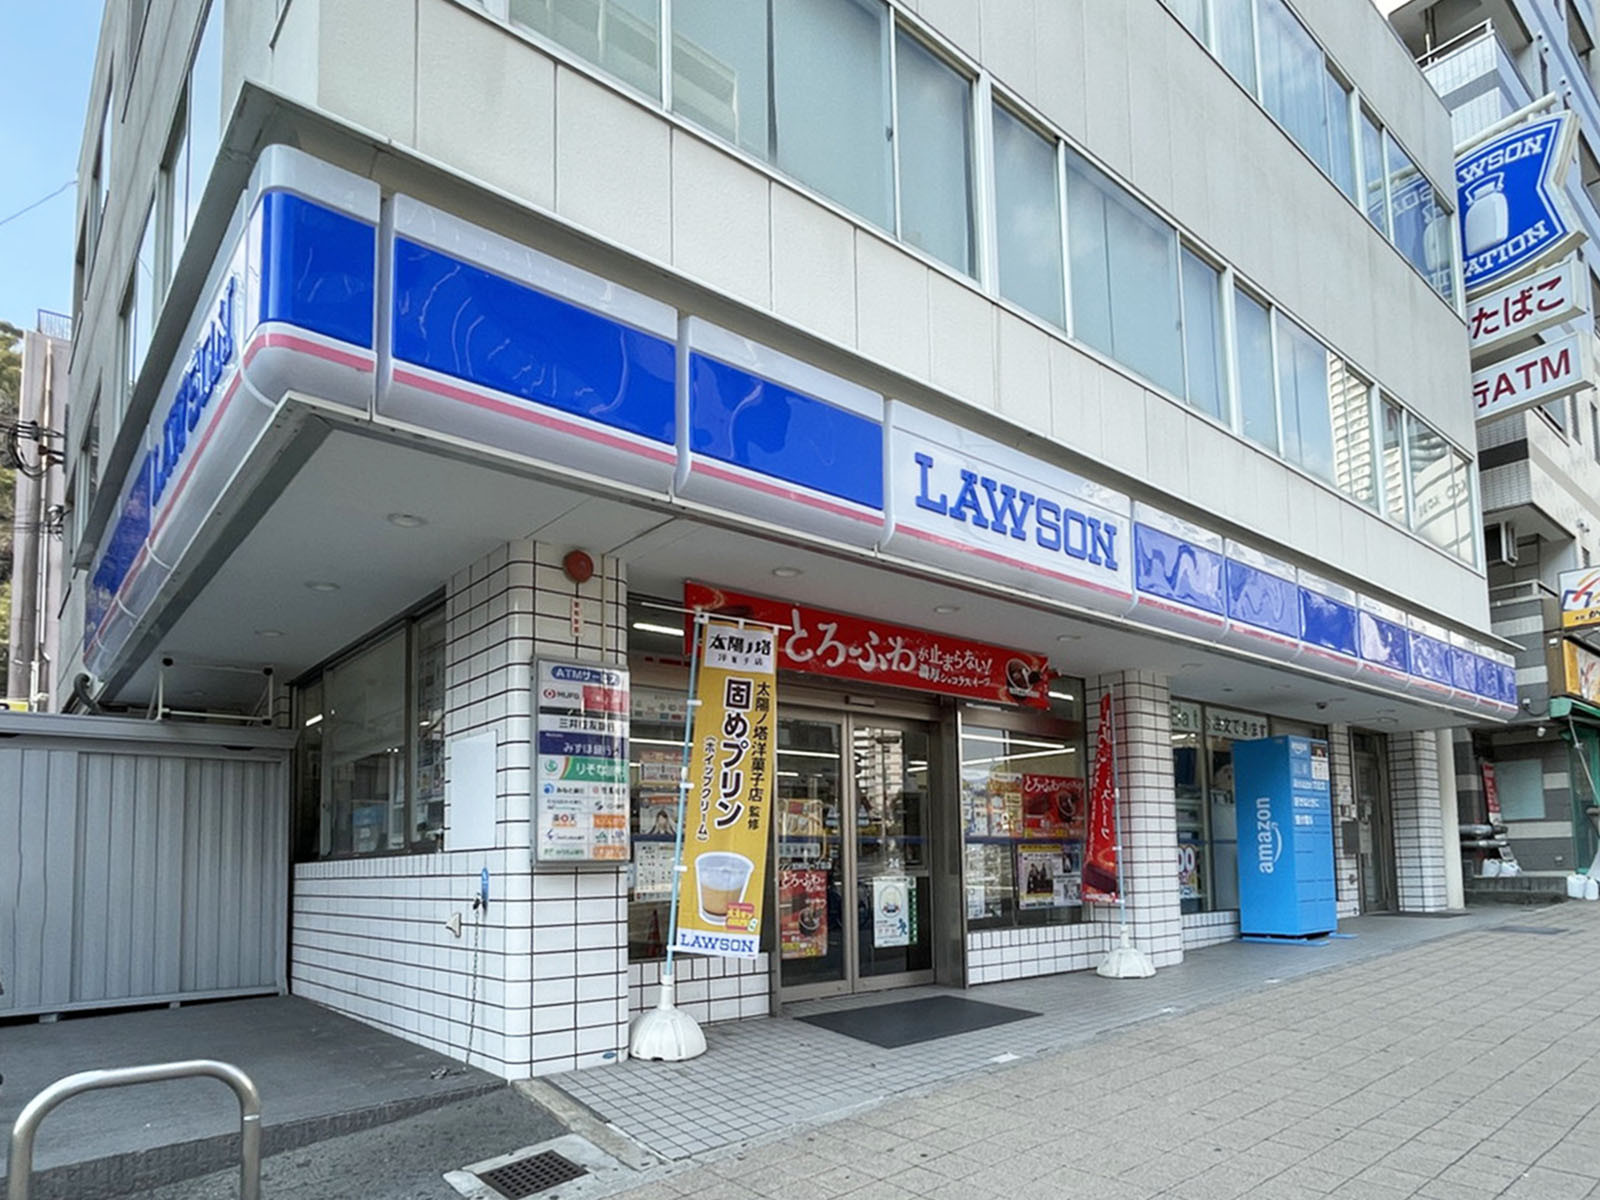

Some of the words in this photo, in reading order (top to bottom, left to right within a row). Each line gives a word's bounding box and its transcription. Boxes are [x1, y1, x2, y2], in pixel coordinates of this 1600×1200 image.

[1456, 133, 1546, 188] WSON
[1463, 219, 1549, 277] ATION
[1471, 276, 1565, 339] たばこ
[914, 452, 1118, 571] LAWSON
[716, 678, 752, 828] 固めプリン
[749, 681, 771, 802] 太陽ノ塔洋菓子店
[1256, 797, 1275, 874] amazon
[680, 933, 755, 953] LAWSON
